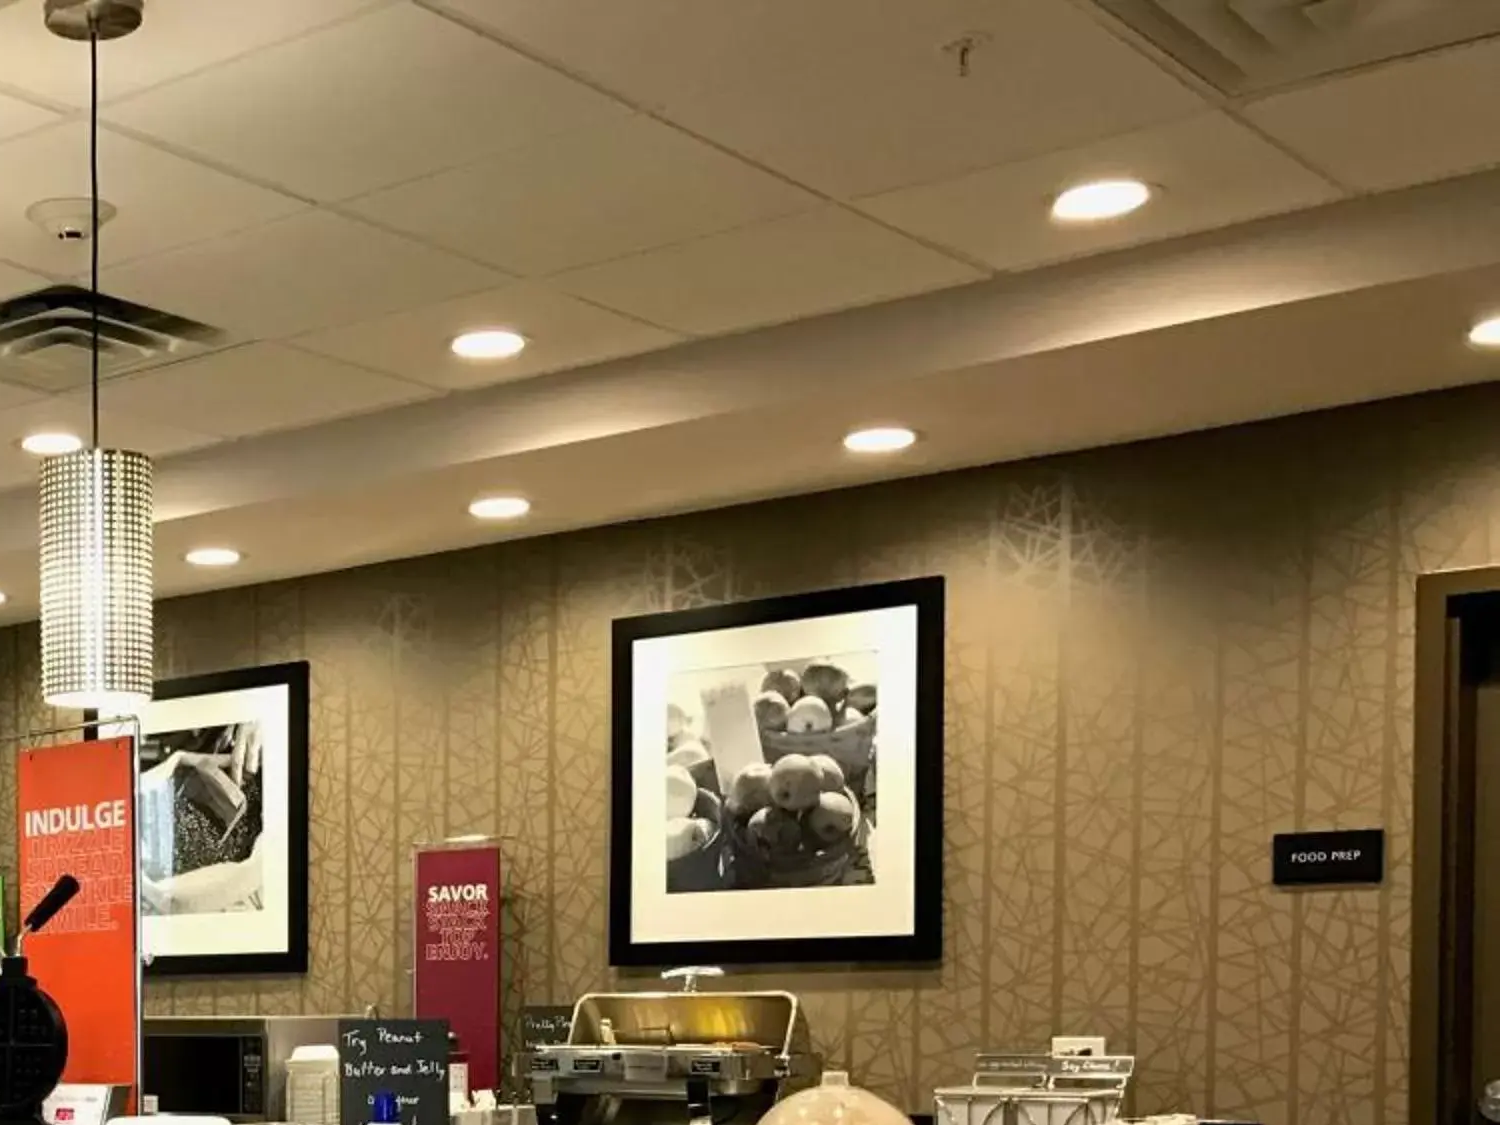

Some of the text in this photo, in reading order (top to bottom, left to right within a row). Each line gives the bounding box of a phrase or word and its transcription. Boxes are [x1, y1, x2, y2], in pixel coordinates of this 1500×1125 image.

[24, 799, 126, 838] INDULGE
[30, 829, 125, 858] DRIZZLE
[1290, 849, 1362, 863] FOOD PREP
[26, 852, 125, 884] SPREAD
[427, 883, 489, 902] SAVOR
[33, 904, 119, 933] MILE.
[425, 942, 489, 961] ENJOY.
[342, 1026, 424, 1056] Try Peanut
[344, 1059, 446, 1081] Butter and Jelly
